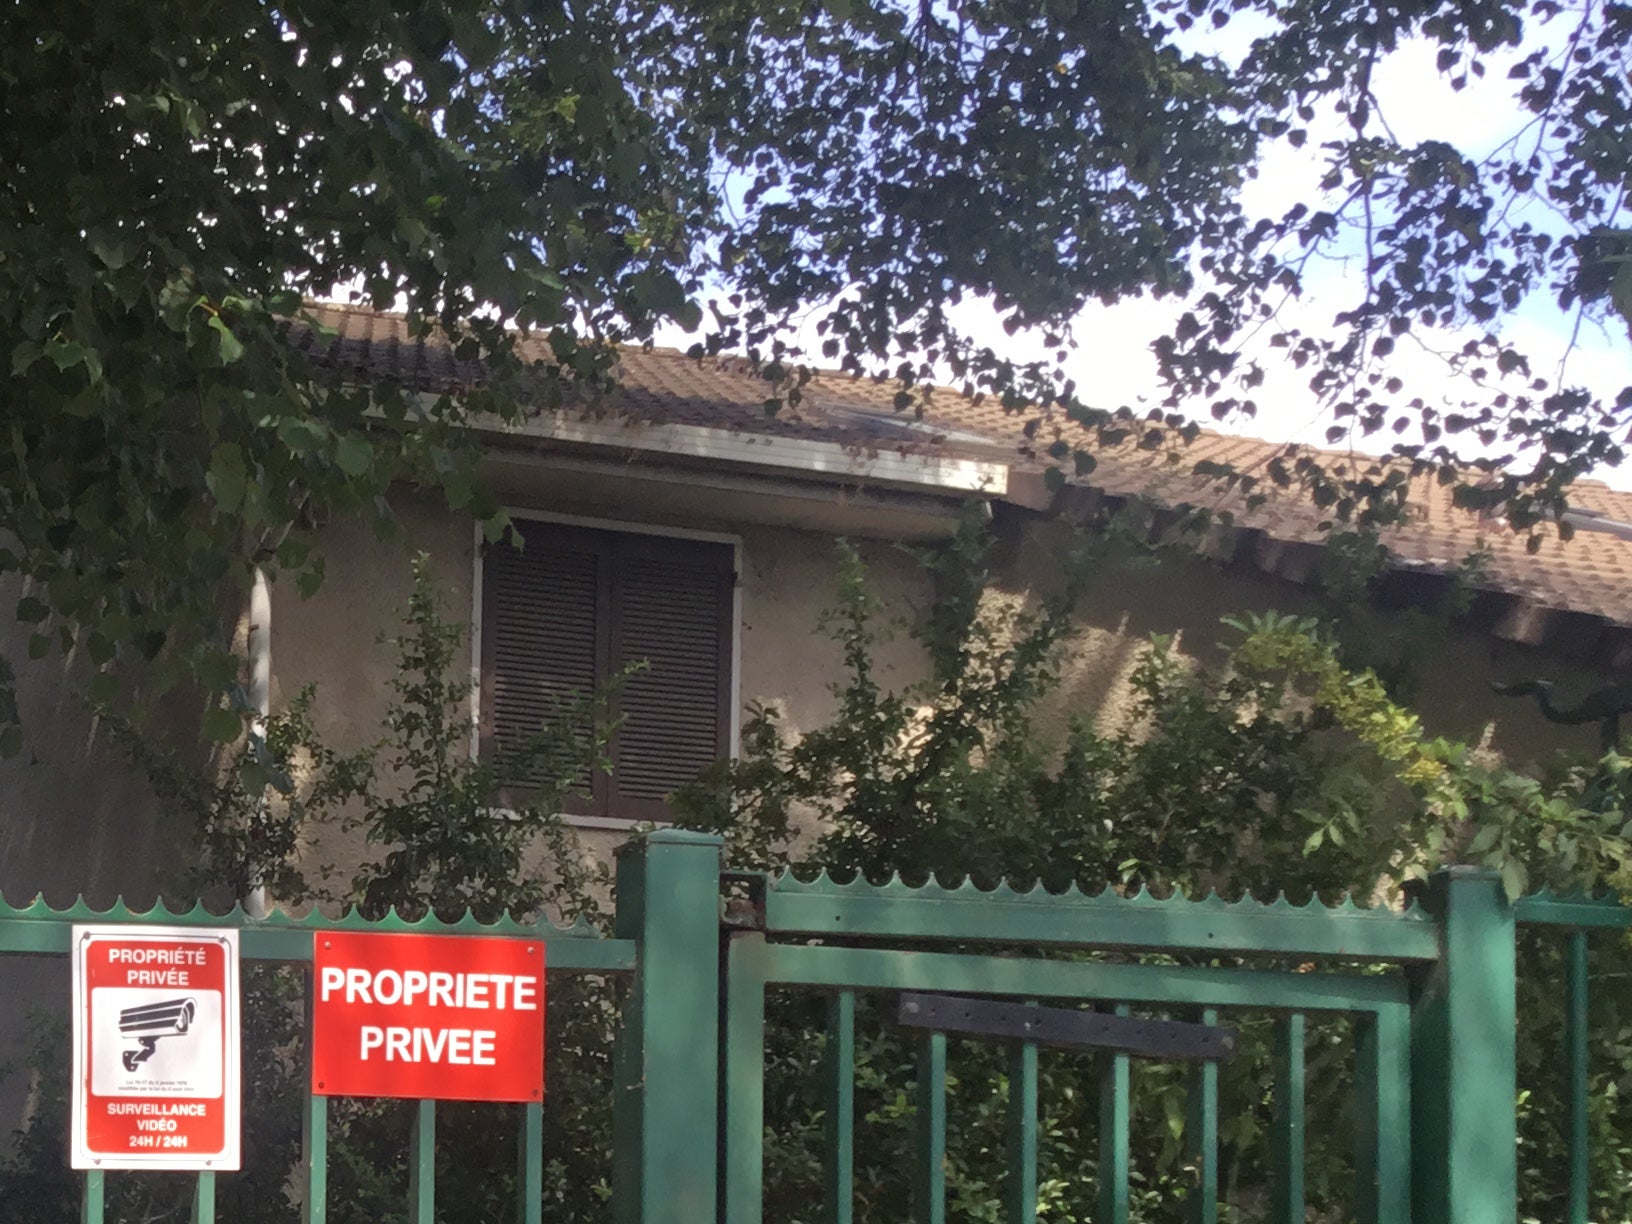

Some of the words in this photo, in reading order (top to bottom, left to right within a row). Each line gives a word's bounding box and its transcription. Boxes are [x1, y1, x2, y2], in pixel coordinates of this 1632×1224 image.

[108, 947, 206, 965] PROPRIÉTÉ
[128, 967, 189, 986] PRIVÉE
[322, 967, 537, 1011] PROPRIETE
[360, 1026, 497, 1066] PRIVEE
[107, 1103, 206, 1117] SURVEILLANCE
[137, 1117, 177, 1132] VIDÉO
[129, 1135, 154, 1148] 24H
[163, 1135, 188, 1149] 24H
